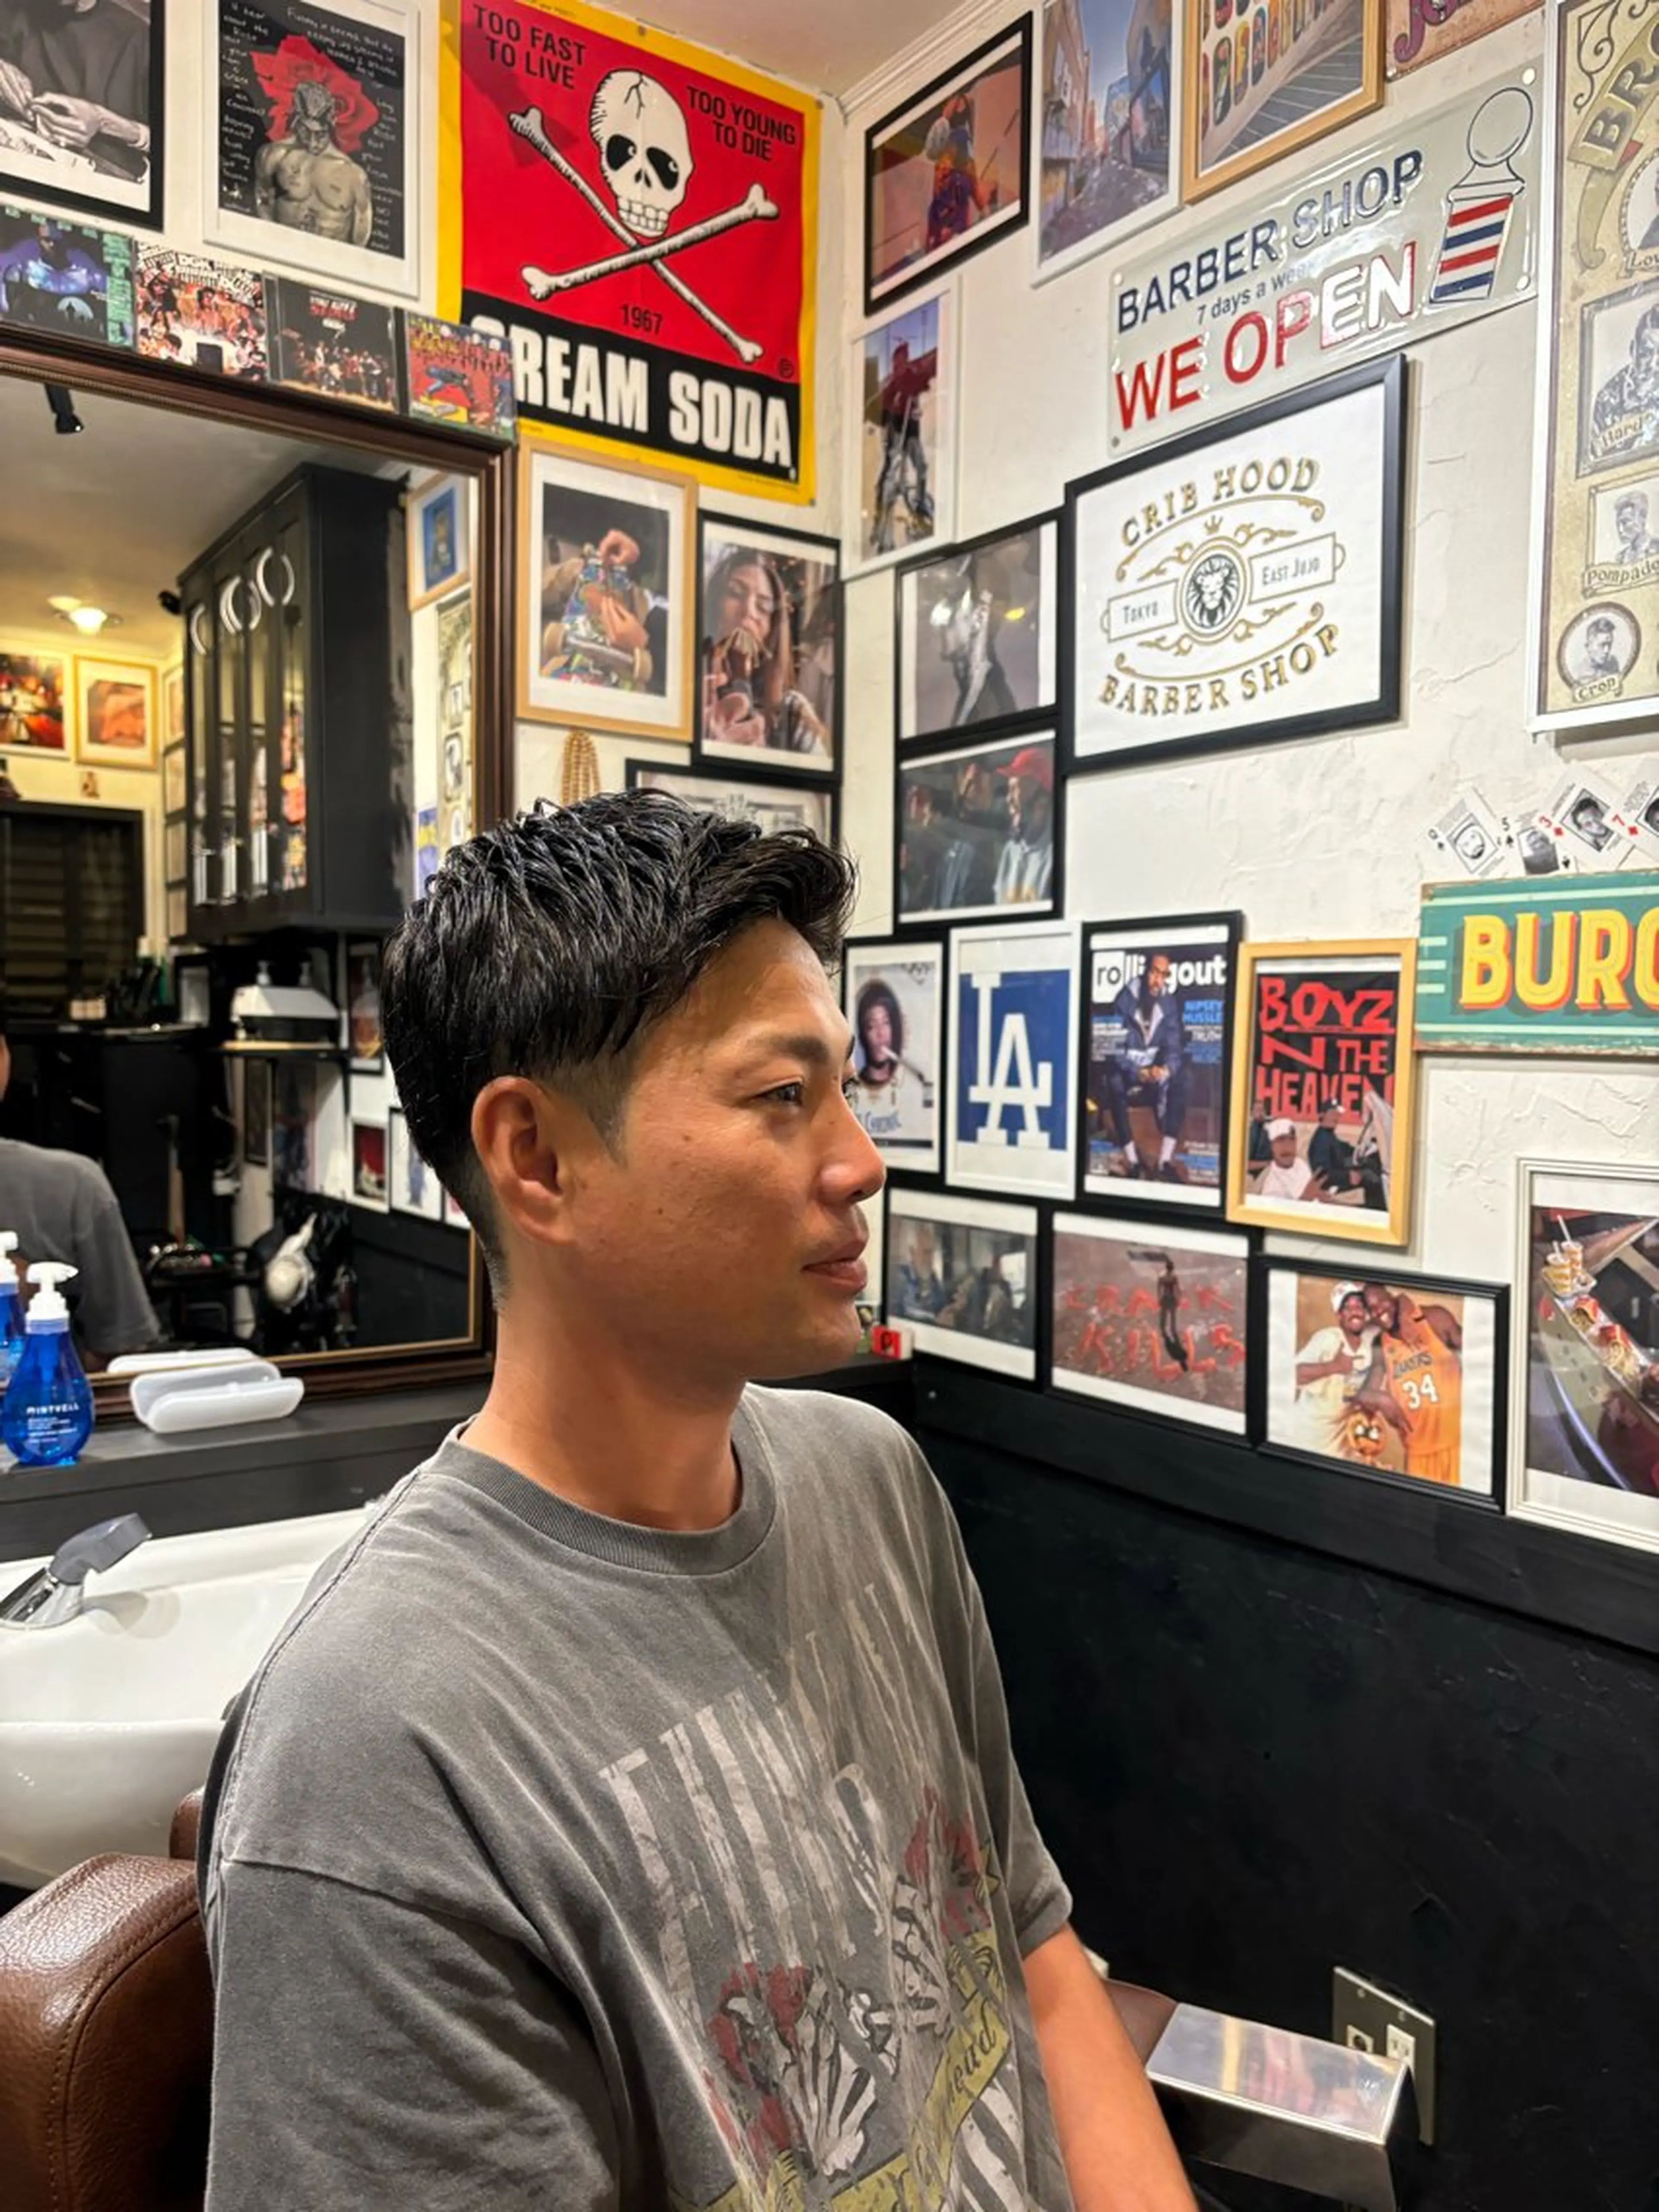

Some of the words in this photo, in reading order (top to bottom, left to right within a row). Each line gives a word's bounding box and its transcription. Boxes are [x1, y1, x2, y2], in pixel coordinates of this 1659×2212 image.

[473, 4, 521, 42] TOO
[530, 26, 587, 66] FAST
[486, 35, 516, 67] TO
[525, 50, 575, 90] LIVE
[686, 85, 725, 120] TOO
[730, 102, 796, 145] YOUNG
[1580, 22, 1659, 154] BR
[713, 119, 737, 149] TO
[742, 130, 773, 162] DIE
[1117, 218, 1279, 334] BARBER
[1292, 149, 1425, 249] SHOP
[620, 303, 664, 335] 1967
[1197, 304, 1207, 325] 7
[1210, 288, 1252, 319] days
[1255, 281, 1266, 299] a
[1115, 335, 1203, 432] WE
[1223, 240, 1419, 385] OPEN
[470, 314, 649, 432] REAM
[668, 369, 792, 468] SODA
[1121, 480, 1199, 547] CRIB
[1212, 456, 1321, 502] HOOD
[1099, 674, 1231, 718] BARBER
[1240, 623, 1341, 702] SHOP
[1577, 676, 1617, 700] Crop
[1501, 816, 1510, 832] 5
[1538, 815, 1553, 829] 3
[1611, 814, 1625, 826] 7
[1097, 953, 1227, 995] rolligout
[1259, 976, 1396, 1033] BOYZ
[968, 971, 1053, 1149] LA
[1261, 1033, 1326, 1070] N
[1336, 1038, 1389, 1074] THE
[1065, 1282, 1235, 1316] CRAK
[1076, 1321, 1247, 1381] KILLS
[1402, 1373, 1439, 1410] 34
